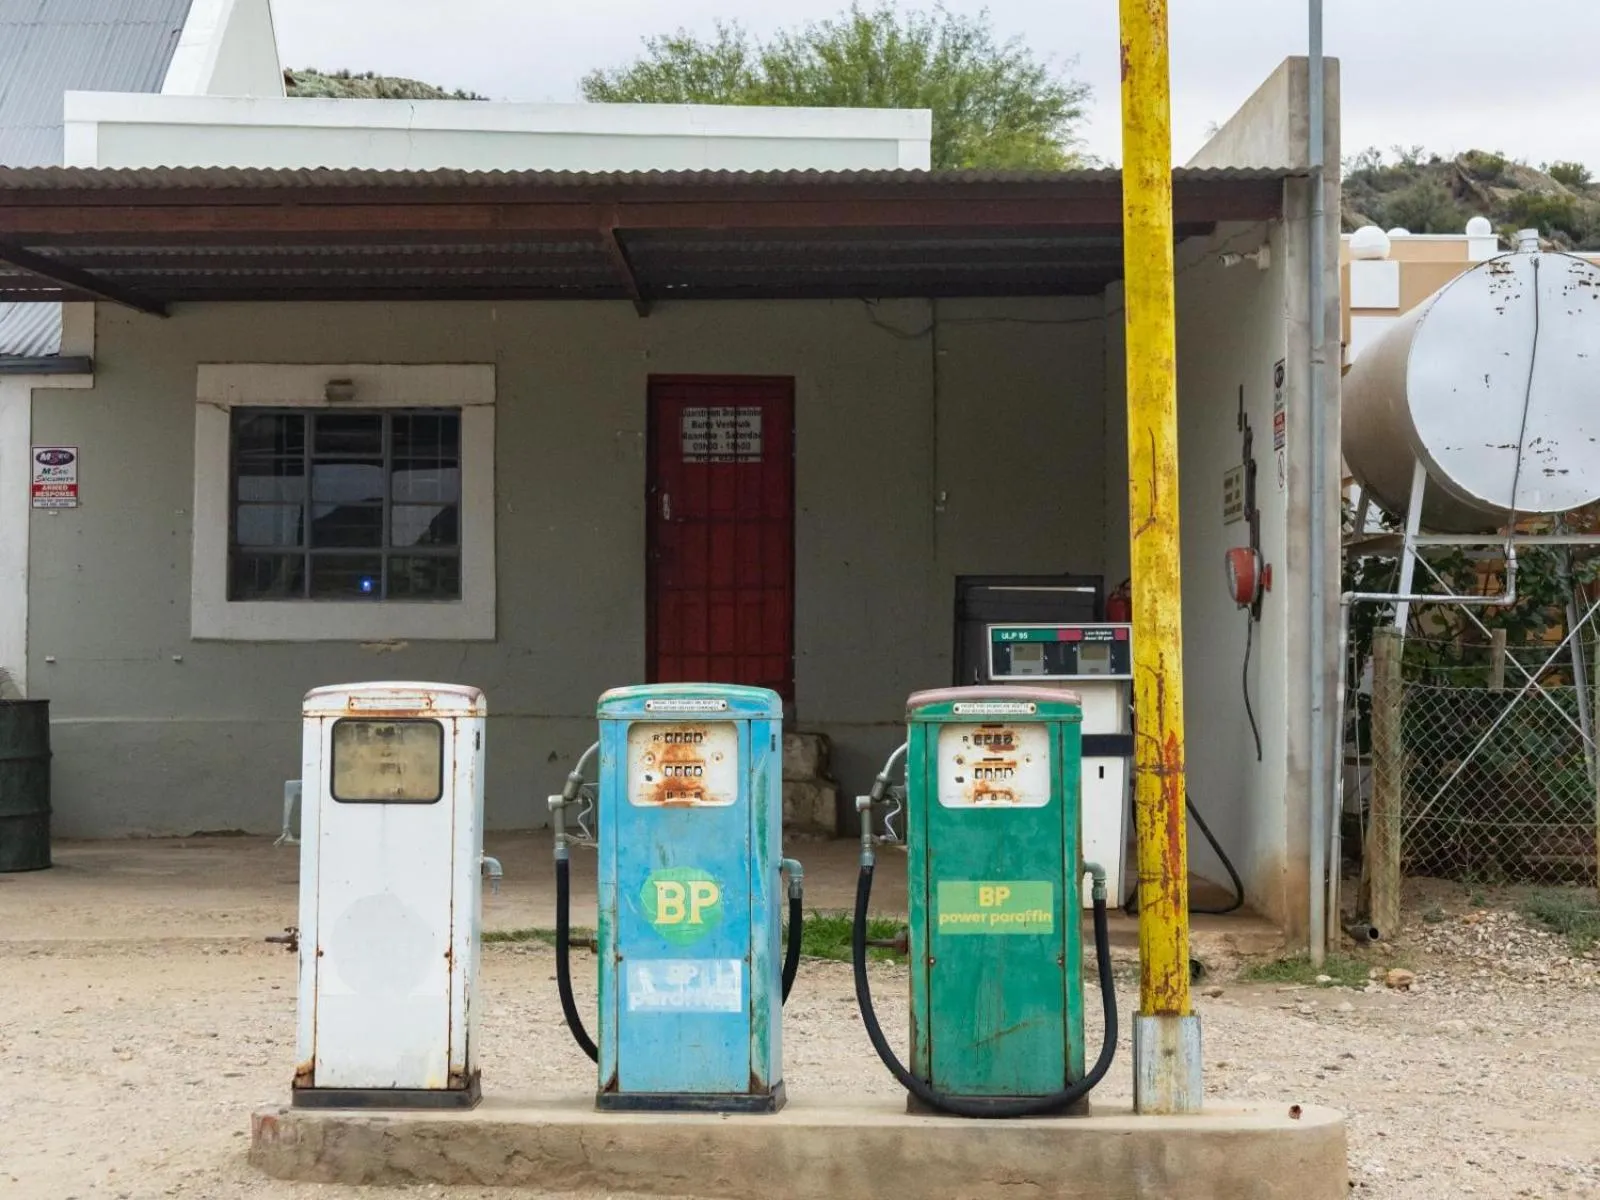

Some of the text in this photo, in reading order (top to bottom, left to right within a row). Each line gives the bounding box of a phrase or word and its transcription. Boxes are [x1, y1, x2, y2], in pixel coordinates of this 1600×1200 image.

[1001, 631, 1017, 640] ULP
[653, 880, 719, 925] BP
[979, 886, 1010, 907] BP
[939, 909, 1051, 927] power paraffin
